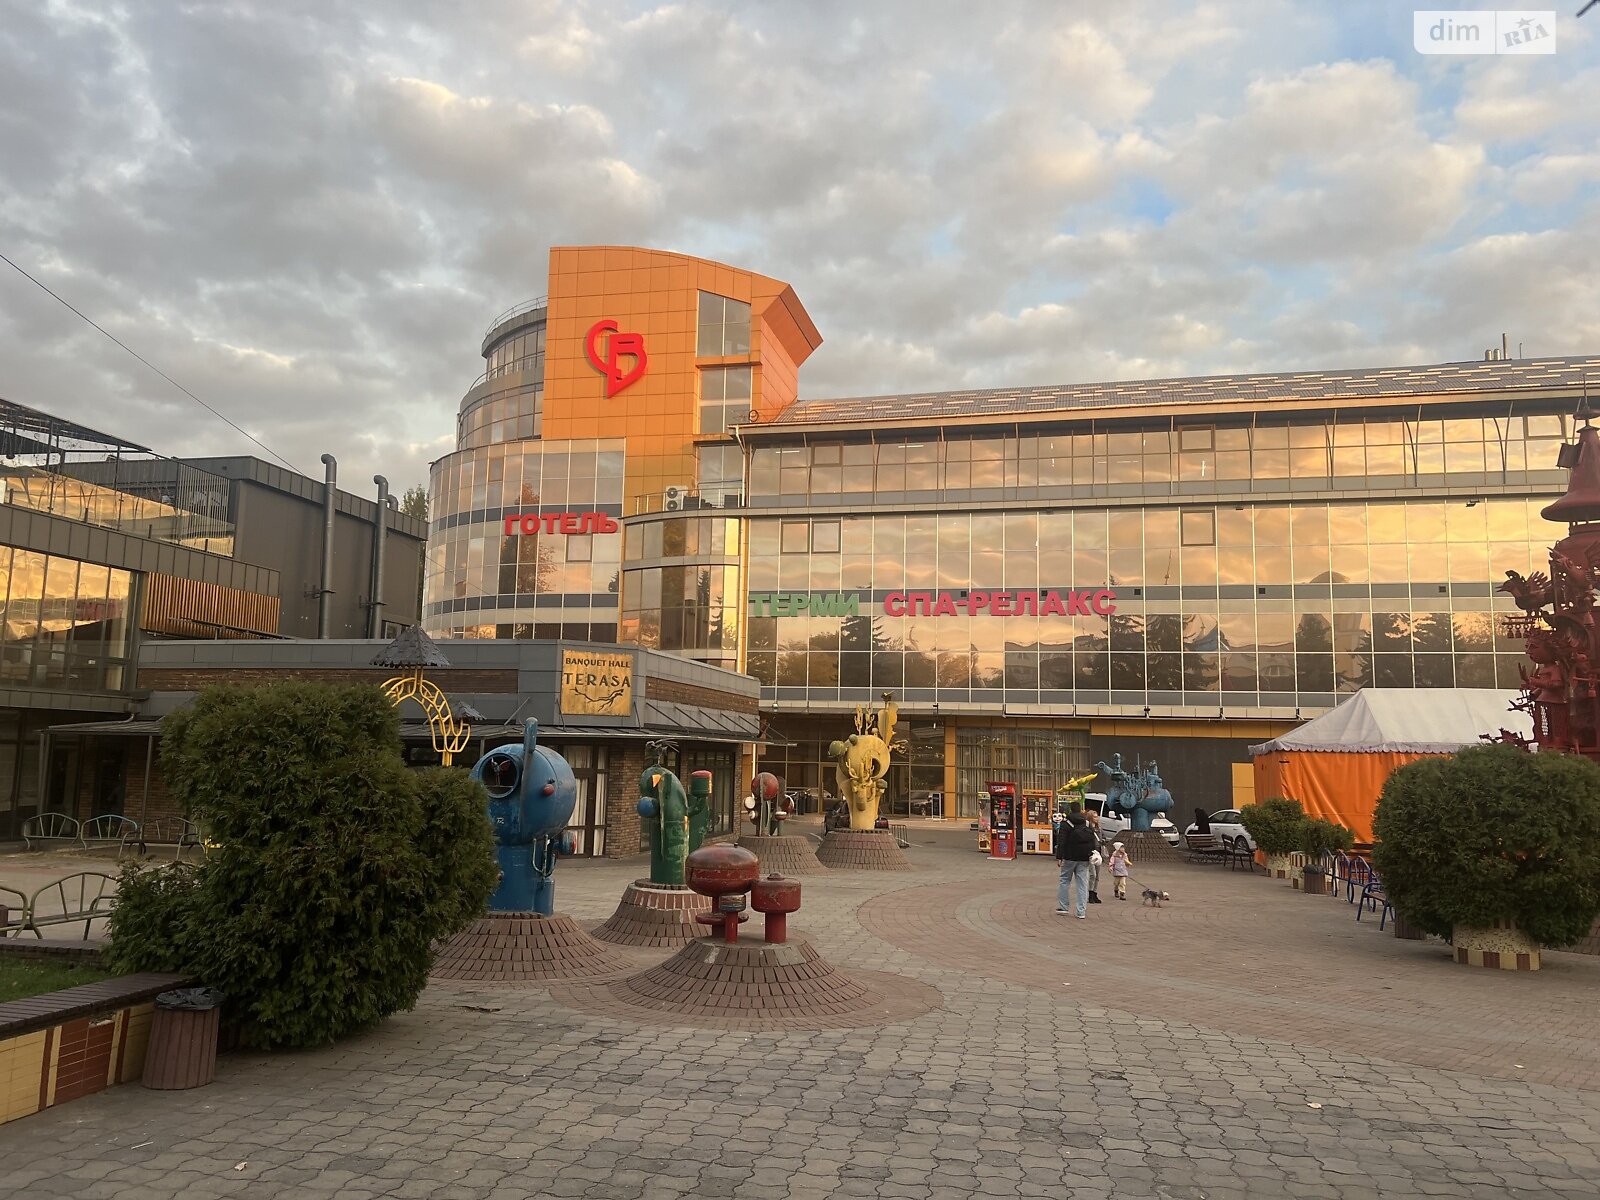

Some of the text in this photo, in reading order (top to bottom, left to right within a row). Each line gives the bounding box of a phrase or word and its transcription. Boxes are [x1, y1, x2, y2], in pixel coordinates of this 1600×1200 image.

[504, 512, 618, 536] ГОТЕЛЬ
[749, 590, 1117, 617] ТЕРМИ СПА-РЕЛАКС
[565, 657, 631, 668] BANQUET HALL
[563, 672, 631, 688] TERASA
